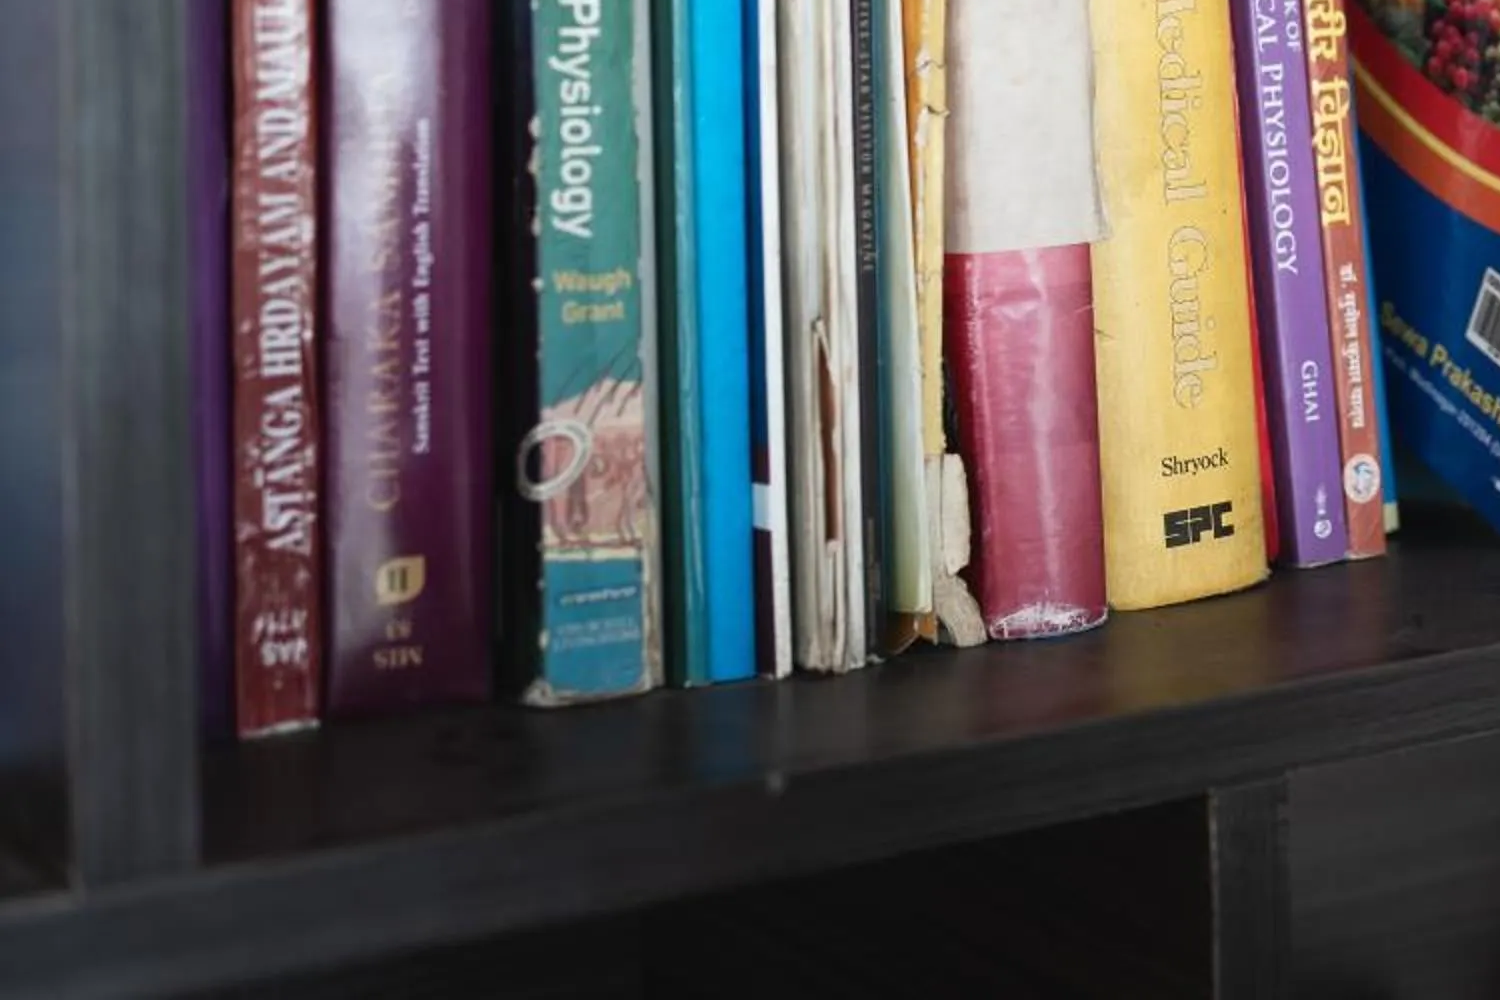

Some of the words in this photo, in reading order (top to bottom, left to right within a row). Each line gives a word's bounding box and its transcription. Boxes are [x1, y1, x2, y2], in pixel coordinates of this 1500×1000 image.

[1286, 24, 1301, 53] OF
[256, 108, 300, 180] AND
[413, 117, 431, 215] Translation
[1262, 63, 1299, 276] PHYSIOLOGY
[1312, 75, 1351, 227] विज्ञान
[412, 220, 435, 288] English
[553, 268, 632, 296] Waugh
[412, 293, 430, 332] with
[562, 301, 625, 325] Grant
[1168, 226, 1219, 410] Guide
[412, 382, 430, 455] Sanskrit
[1301, 360, 1320, 423] GHAI
[1161, 447, 1230, 478] Shryock
[1163, 500, 1235, 549] SPC
